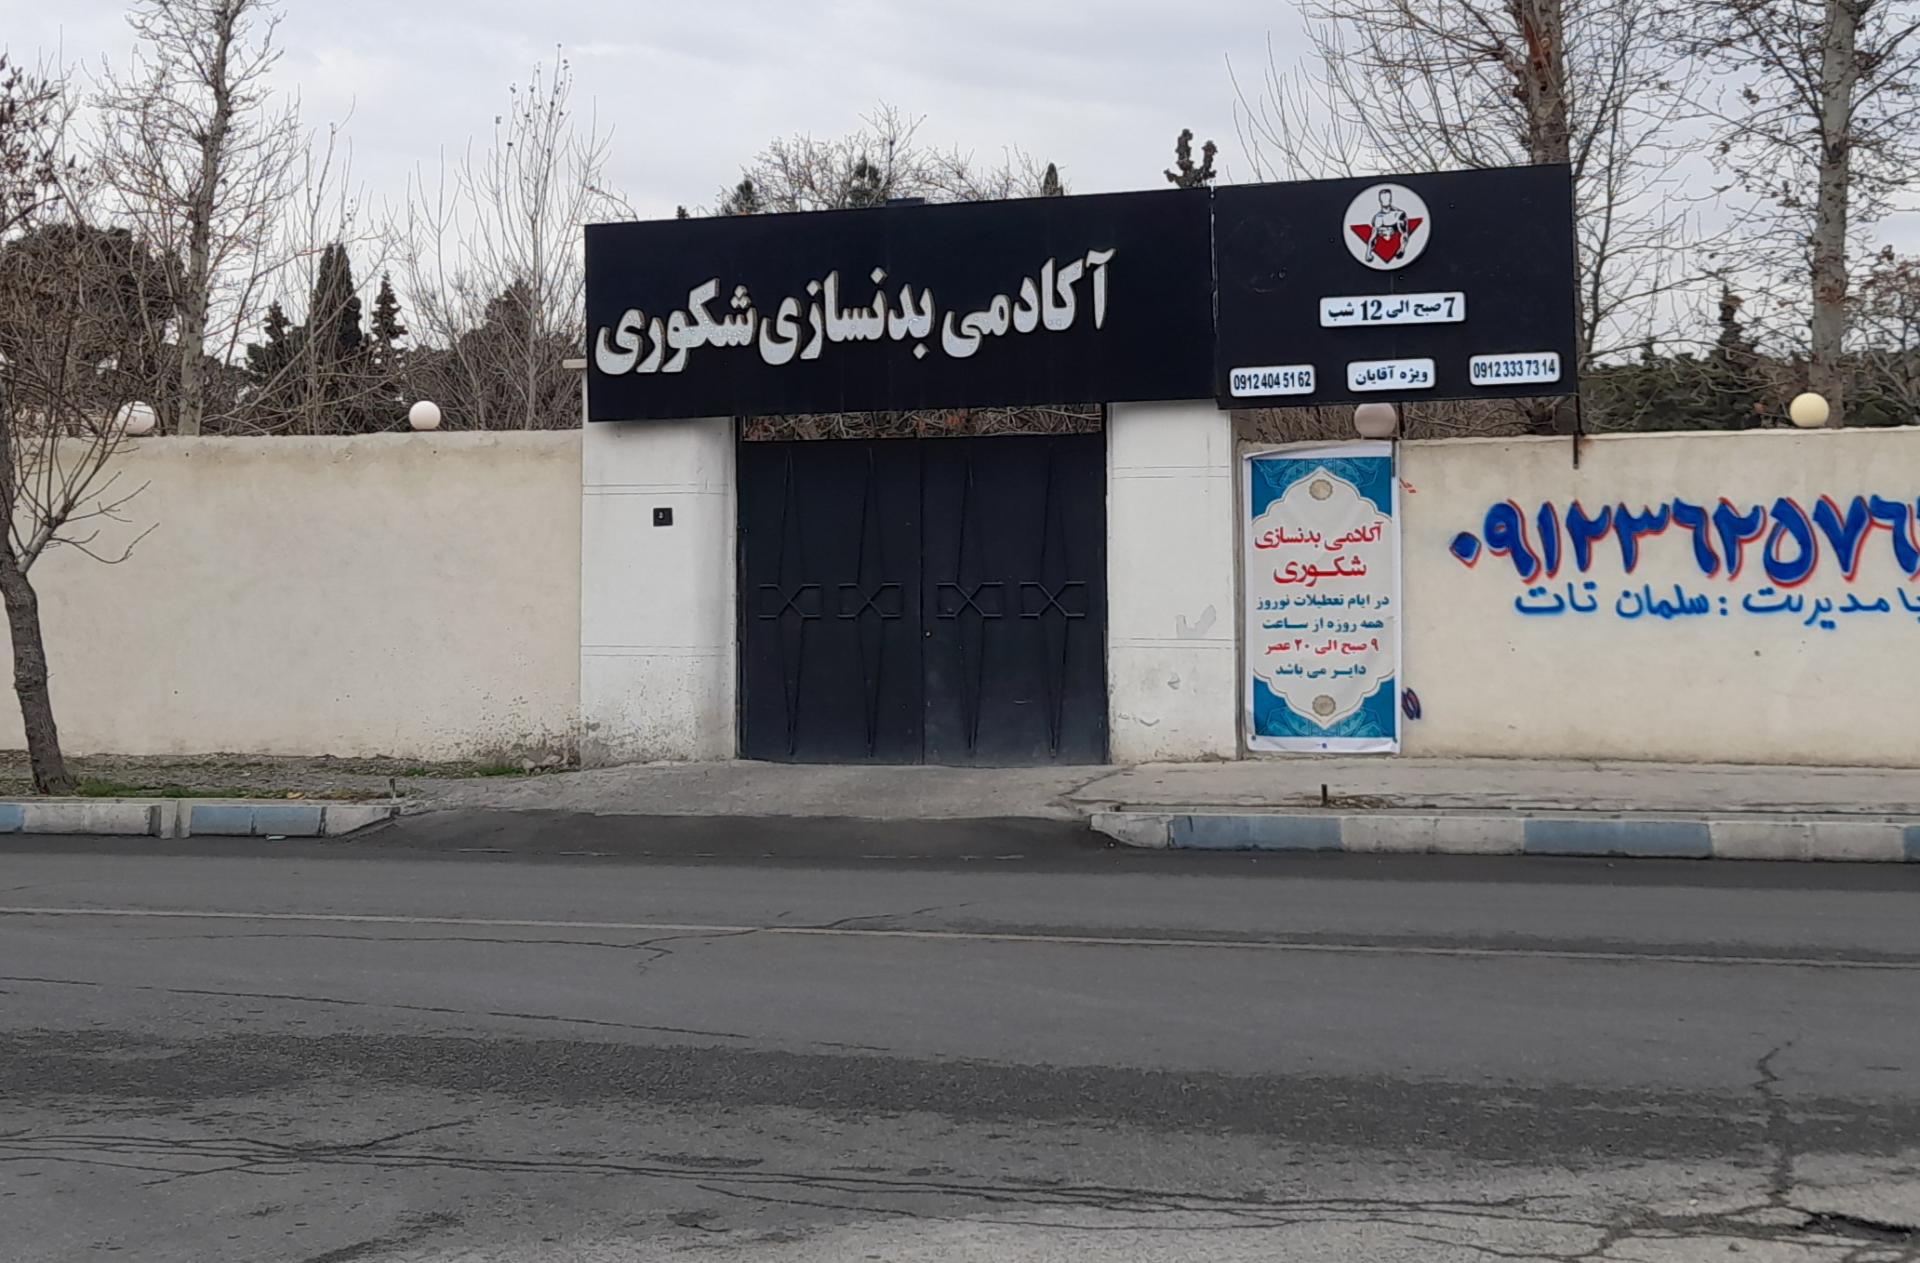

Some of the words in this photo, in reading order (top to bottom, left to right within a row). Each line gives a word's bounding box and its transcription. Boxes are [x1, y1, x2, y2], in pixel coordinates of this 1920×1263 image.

[942, 248, 1117, 359] آکادمی
[1328, 301, 1355, 321] شب
[1360, 299, 1383, 321] 12
[1386, 300, 1410, 318] الی
[1413, 302, 1442, 317] صبح
[1444, 297, 1456, 318] 7
[758, 266, 936, 366] بدنسازی
[595, 278, 757, 375] شکوری
[1355, 365, 1396, 386] آقایان
[1400, 368, 1428, 383] ویژه
[1254, 526, 1322, 549] بدنسازی
[1324, 521, 1384, 551] آکادمی
[1450, 494, 1920, 588] ۰۹۱۲۳۶۲۵۷۶
[1273, 555, 1367, 587] شکوری
[1256, 595, 1290, 610] نوروز
[1293, 594, 1345, 608] تعطیلات
[1347, 594, 1371, 609] ایام
[1373, 595, 1390, 609] در
[1615, 584, 1710, 620] سلمان
[1742, 585, 1891, 630] مدیریت
[1262, 617, 1309, 629] ساعت
[1311, 617, 1324, 632] از
[1327, 619, 1357, 632] روزه
[1360, 619, 1384, 629] همه
[1264, 641, 1291, 655] عصر
[1314, 639, 1337, 655] الی
[1340, 641, 1368, 655] صبح
[1275, 663, 1304, 678] باشد
[1306, 666, 1327, 679] می
